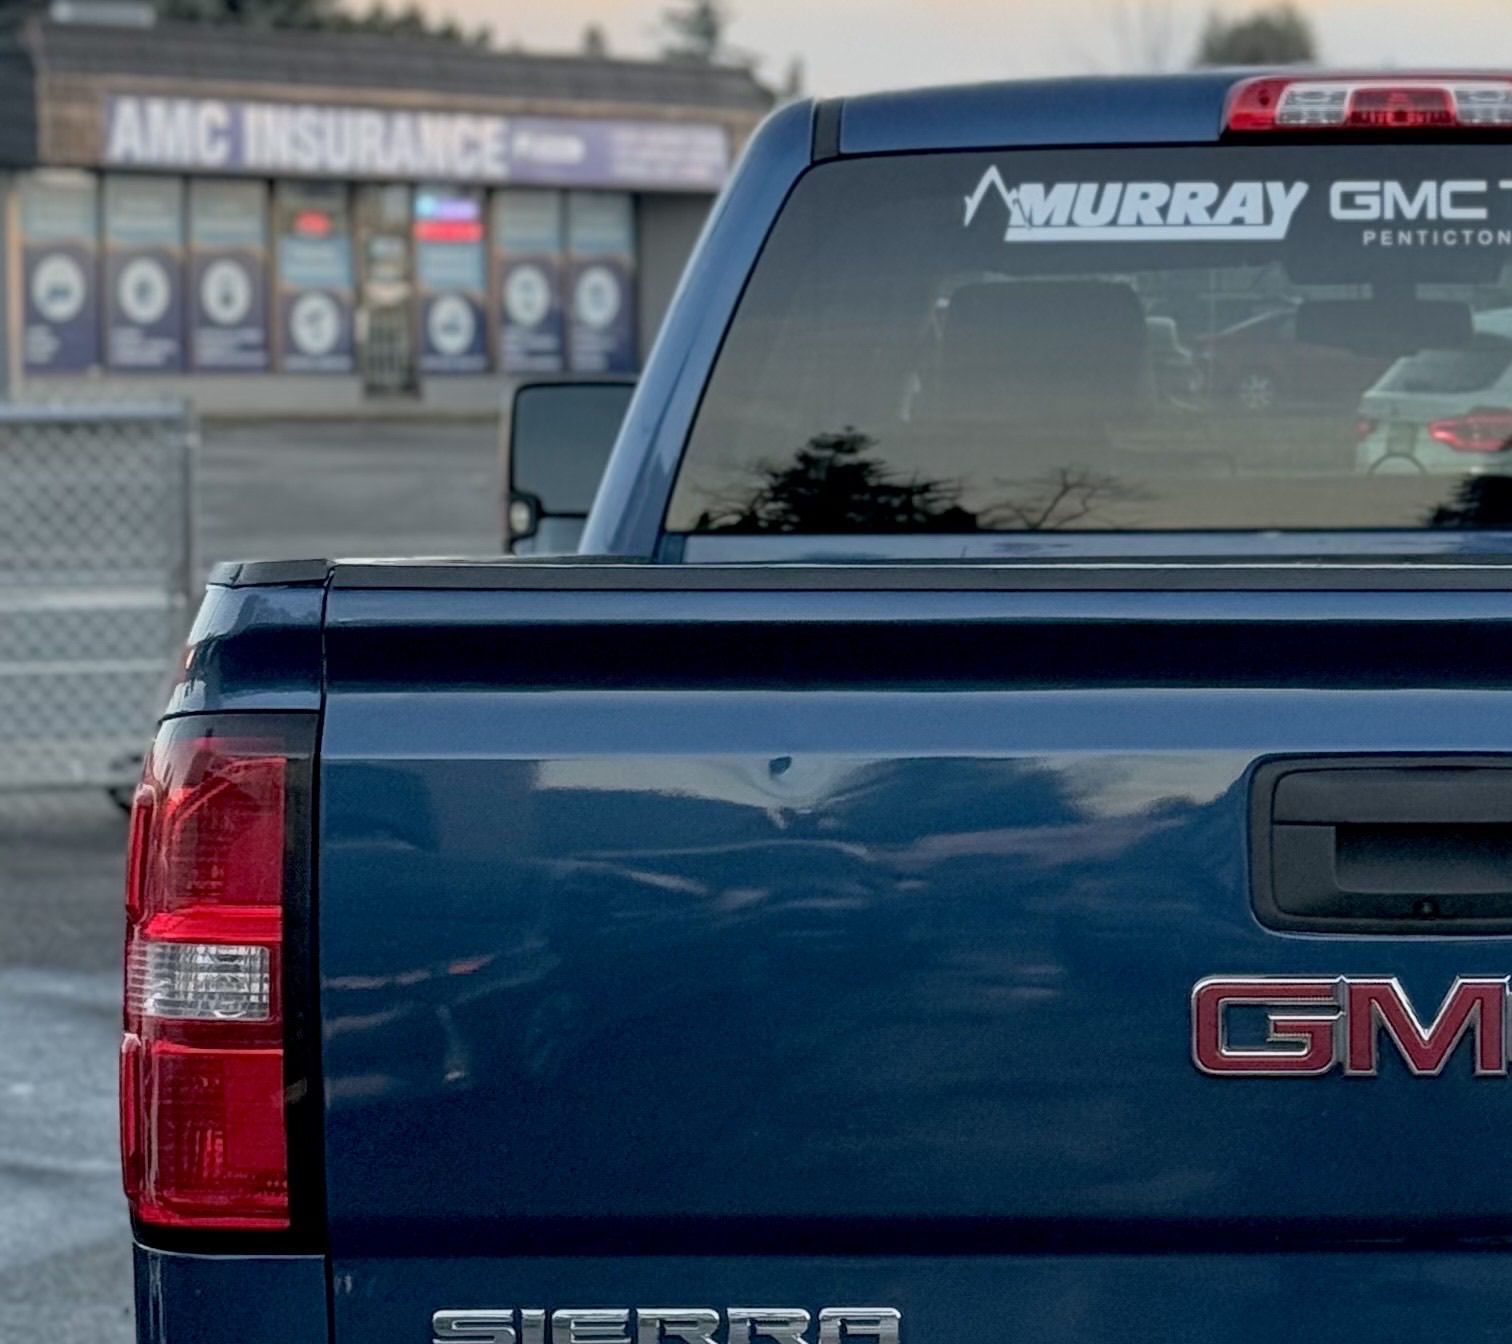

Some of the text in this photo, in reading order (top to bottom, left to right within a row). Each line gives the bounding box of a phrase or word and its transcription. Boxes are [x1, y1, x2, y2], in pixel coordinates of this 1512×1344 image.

[108, 96, 230, 164] AMC
[241, 103, 510, 179] INSURANCE
[1006, 181, 1309, 241] MURRAY
[1329, 180, 1488, 220] GMC
[1362, 229, 1512, 246] PENTICTON
